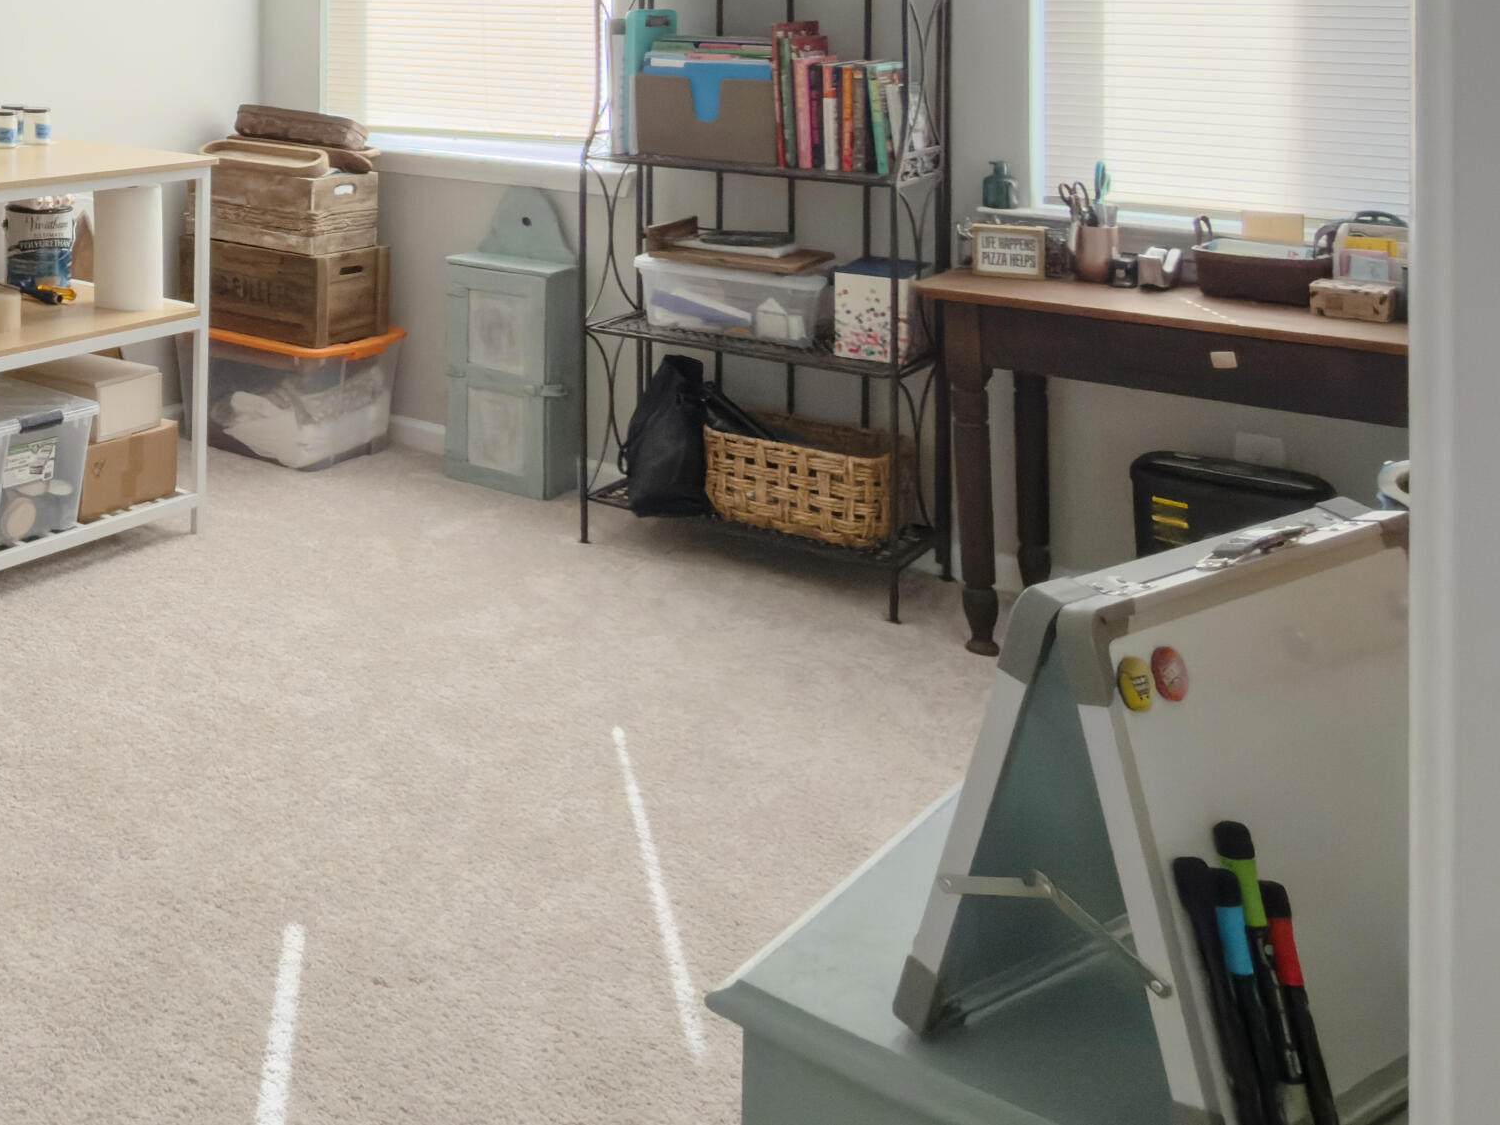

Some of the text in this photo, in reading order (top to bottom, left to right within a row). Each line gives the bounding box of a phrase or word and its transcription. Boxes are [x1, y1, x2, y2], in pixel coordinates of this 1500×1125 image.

[982, 236, 1036, 251] LIFE HAPPENS
[982, 252, 1036, 268] PIZZA HELPS
